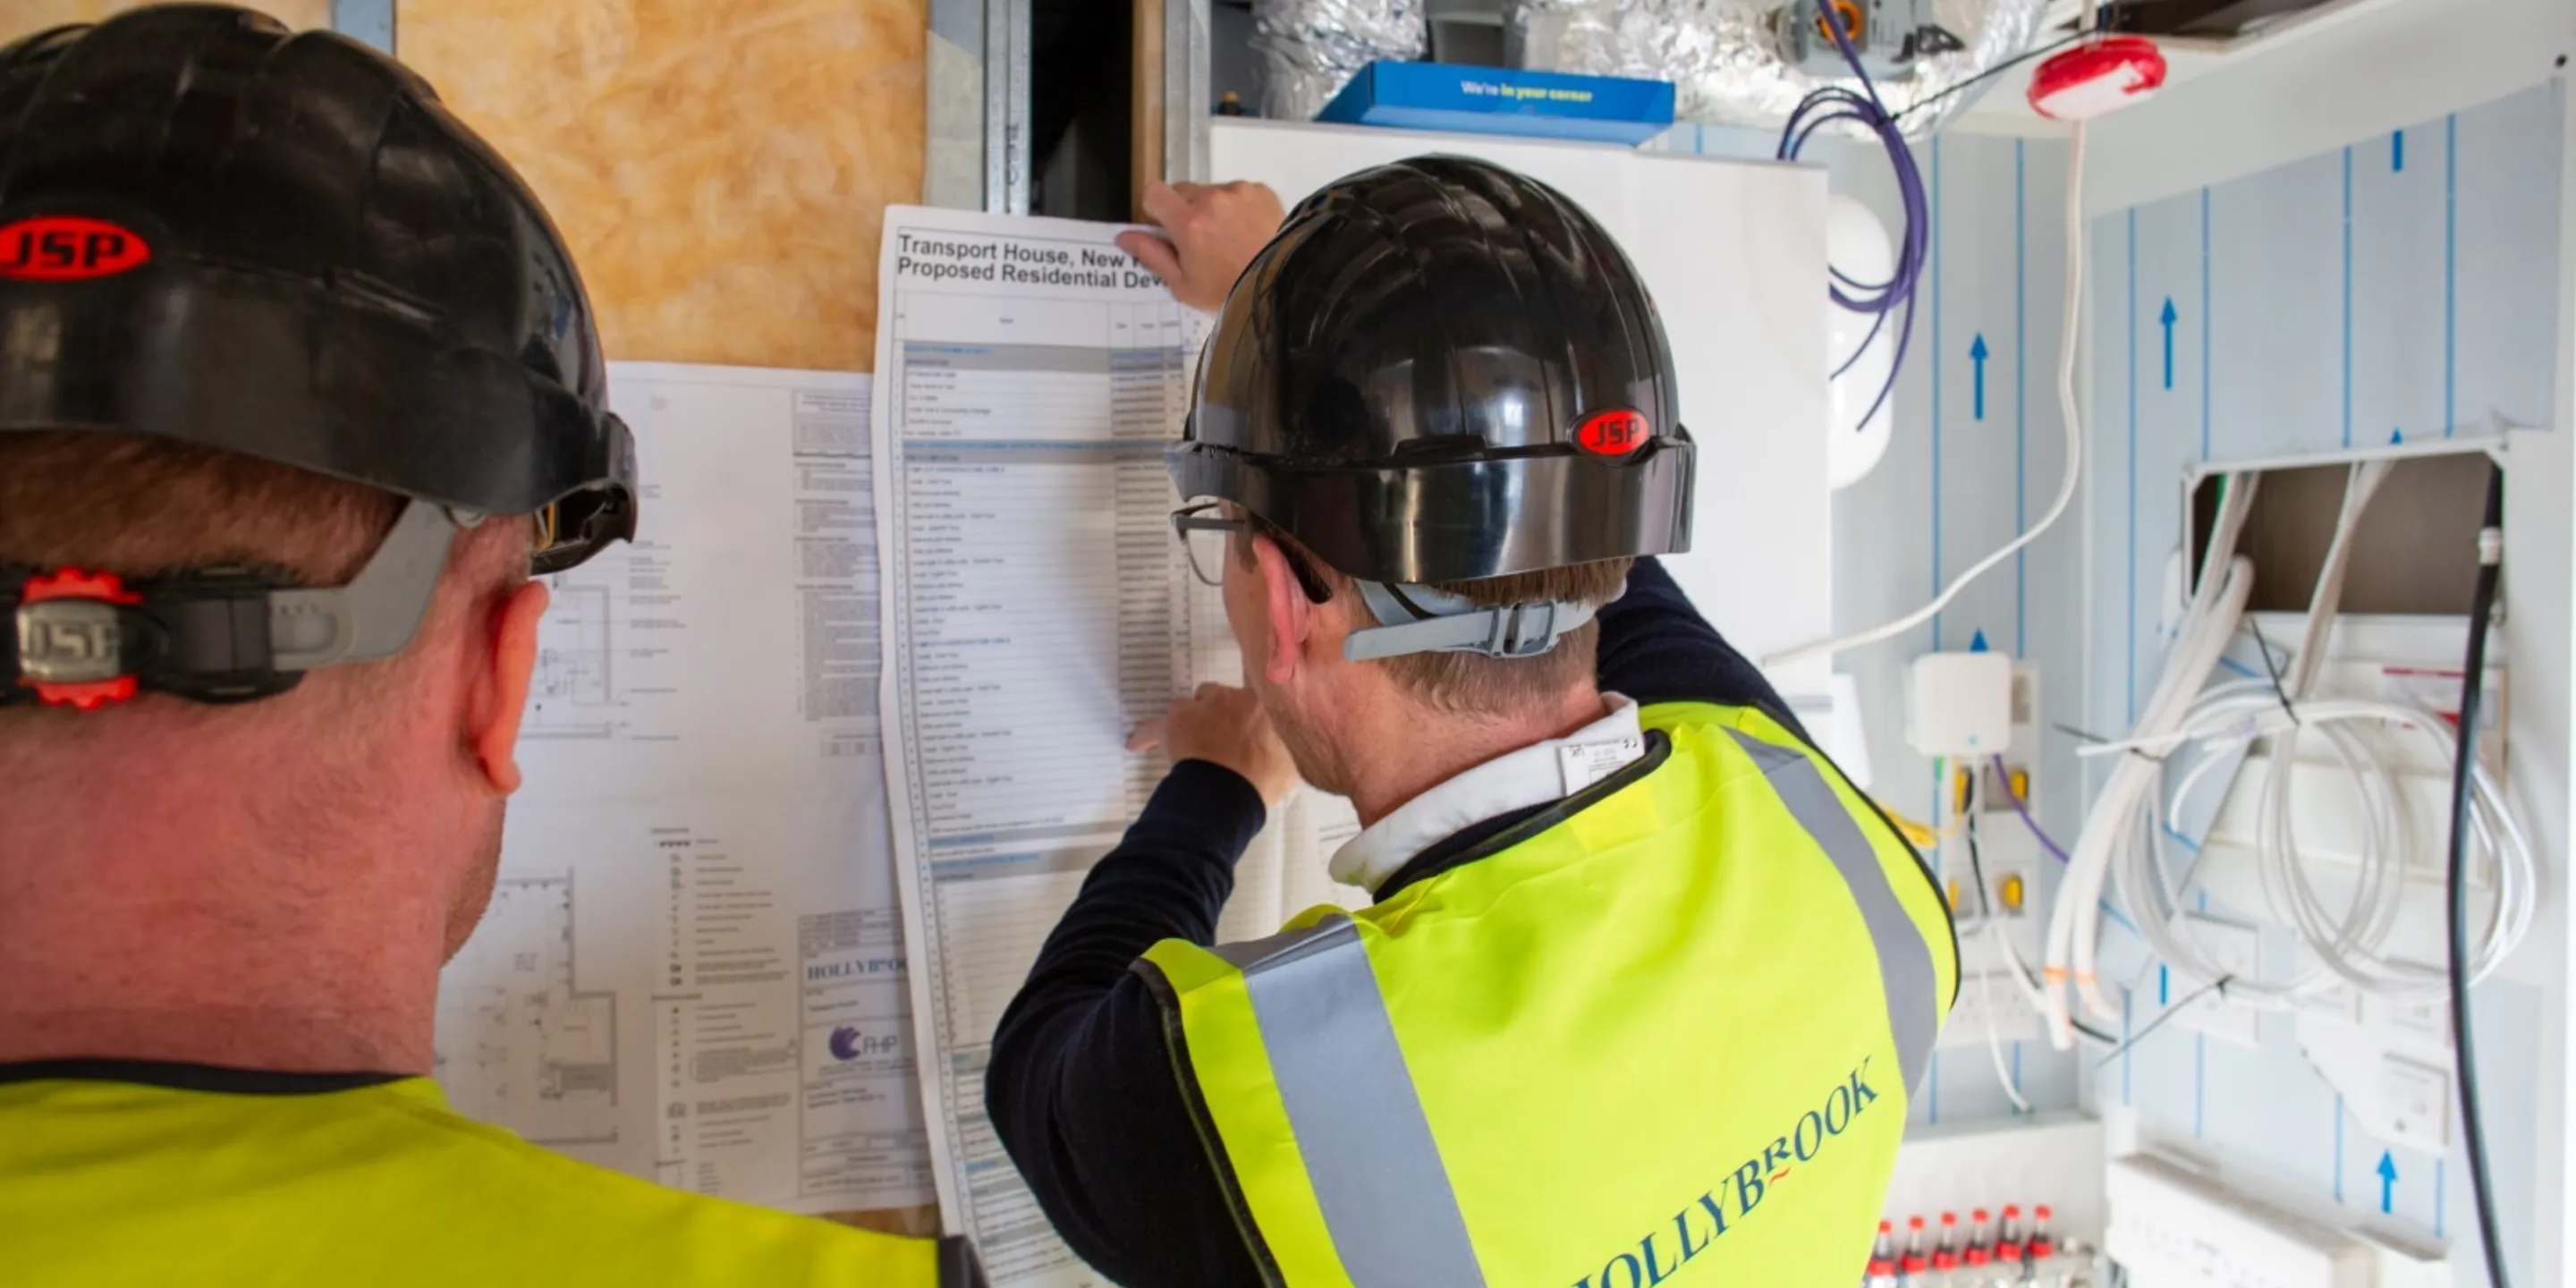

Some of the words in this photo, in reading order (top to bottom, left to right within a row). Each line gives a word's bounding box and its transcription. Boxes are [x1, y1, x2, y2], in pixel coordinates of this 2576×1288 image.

[1460, 80, 1498, 96] We're
[1500, 82, 1514, 97] in
[1515, 87, 1546, 100] your
[1548, 89, 1592, 102] corner
[0, 231, 125, 267] JSP
[898, 234, 997, 260] Transport
[1004, 243, 1075, 268] House,
[1081, 248, 1125, 267] New
[897, 256, 995, 281] Proposed
[1001, 264, 1117, 288] Residential
[1123, 271, 1167, 289] Dev
[1591, 418, 1641, 446] JSP
[1571, 1055, 1879, 1288] OLLYBROOK
